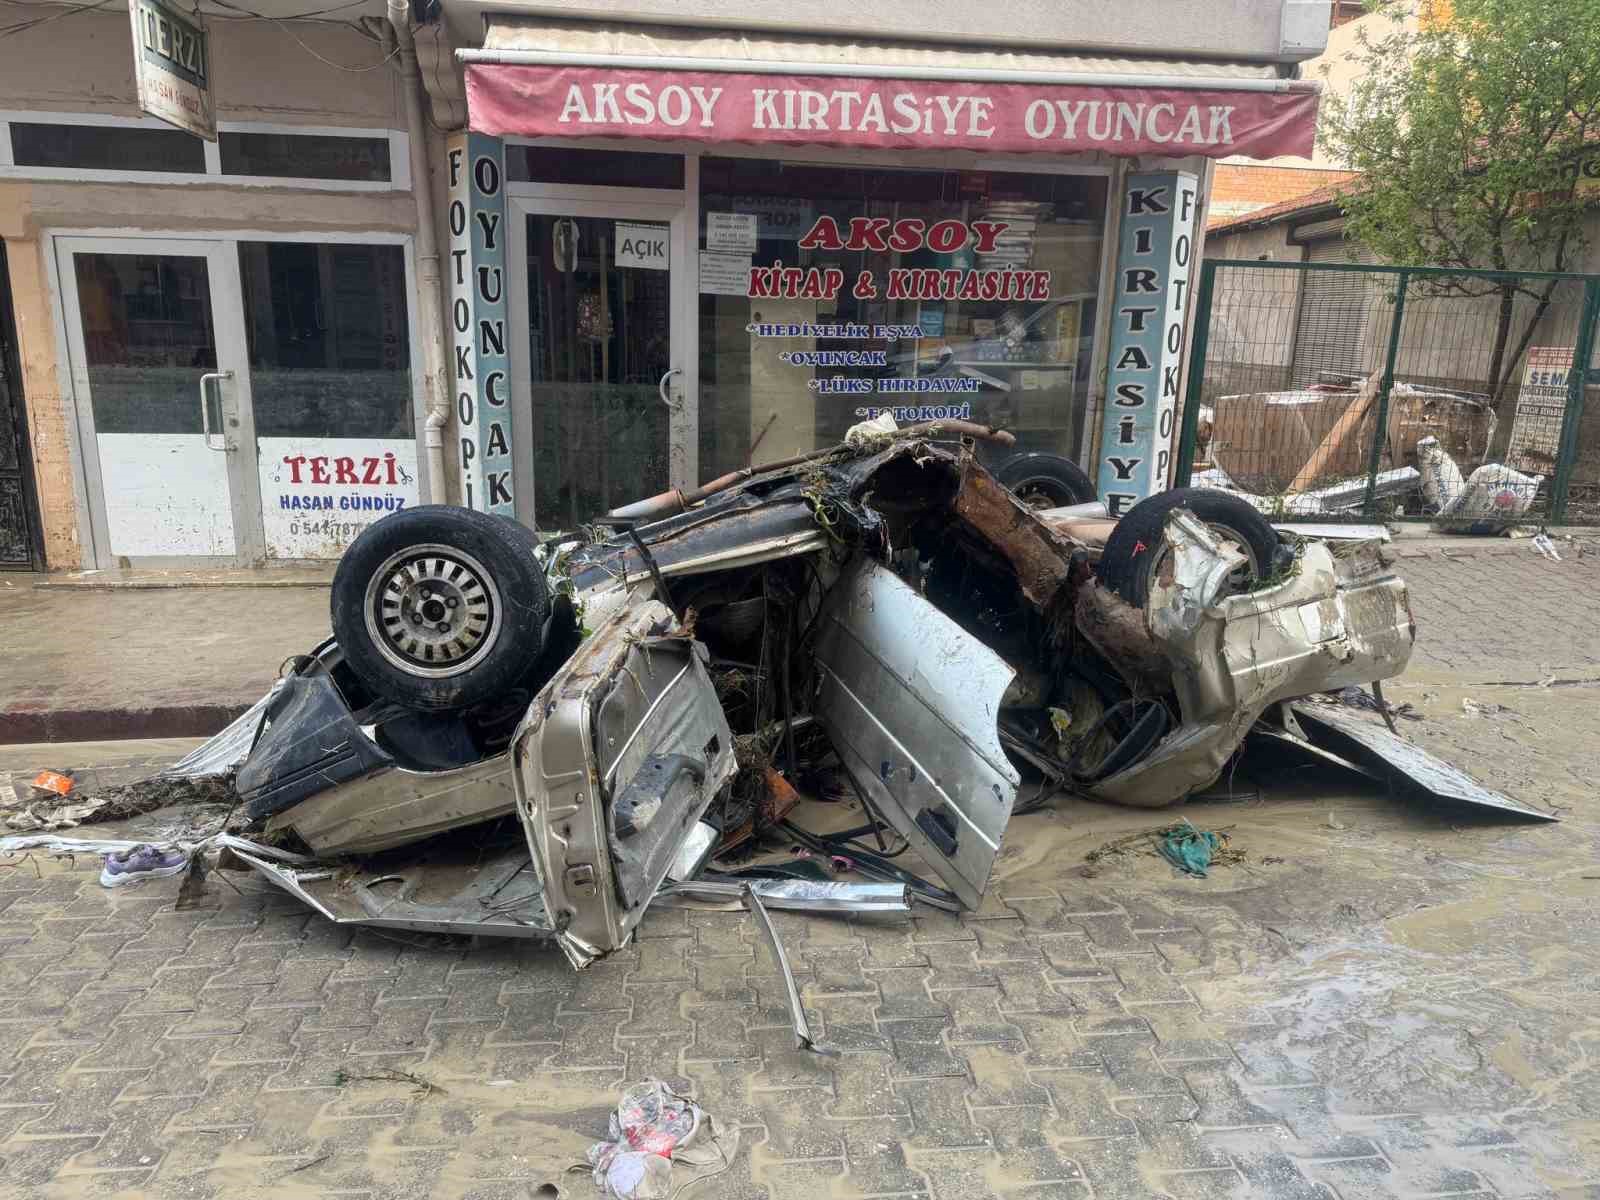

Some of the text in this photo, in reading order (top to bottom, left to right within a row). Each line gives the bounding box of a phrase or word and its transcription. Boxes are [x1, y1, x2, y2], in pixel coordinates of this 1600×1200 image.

[558, 82, 723, 129] AKSOY
[1024, 99, 1236, 146] OYUNCAK
[621, 238, 665, 260] AÇIK
[799, 215, 1010, 254] AKSOY
[747, 259, 845, 300] KİTAP
[853, 270, 877, 300] &
[886, 264, 1051, 300] KIRTASİYE
[474, 156, 513, 506] OYUNCAK
[872, 324, 925, 342] EŞYA
[1156, 189, 1194, 488] FOTOKOP
[876, 377, 983, 394] HIRDAVAT
[283, 452, 399, 485] TERZİ
[280, 492, 406, 512] HASAN GÜNDÜZ
